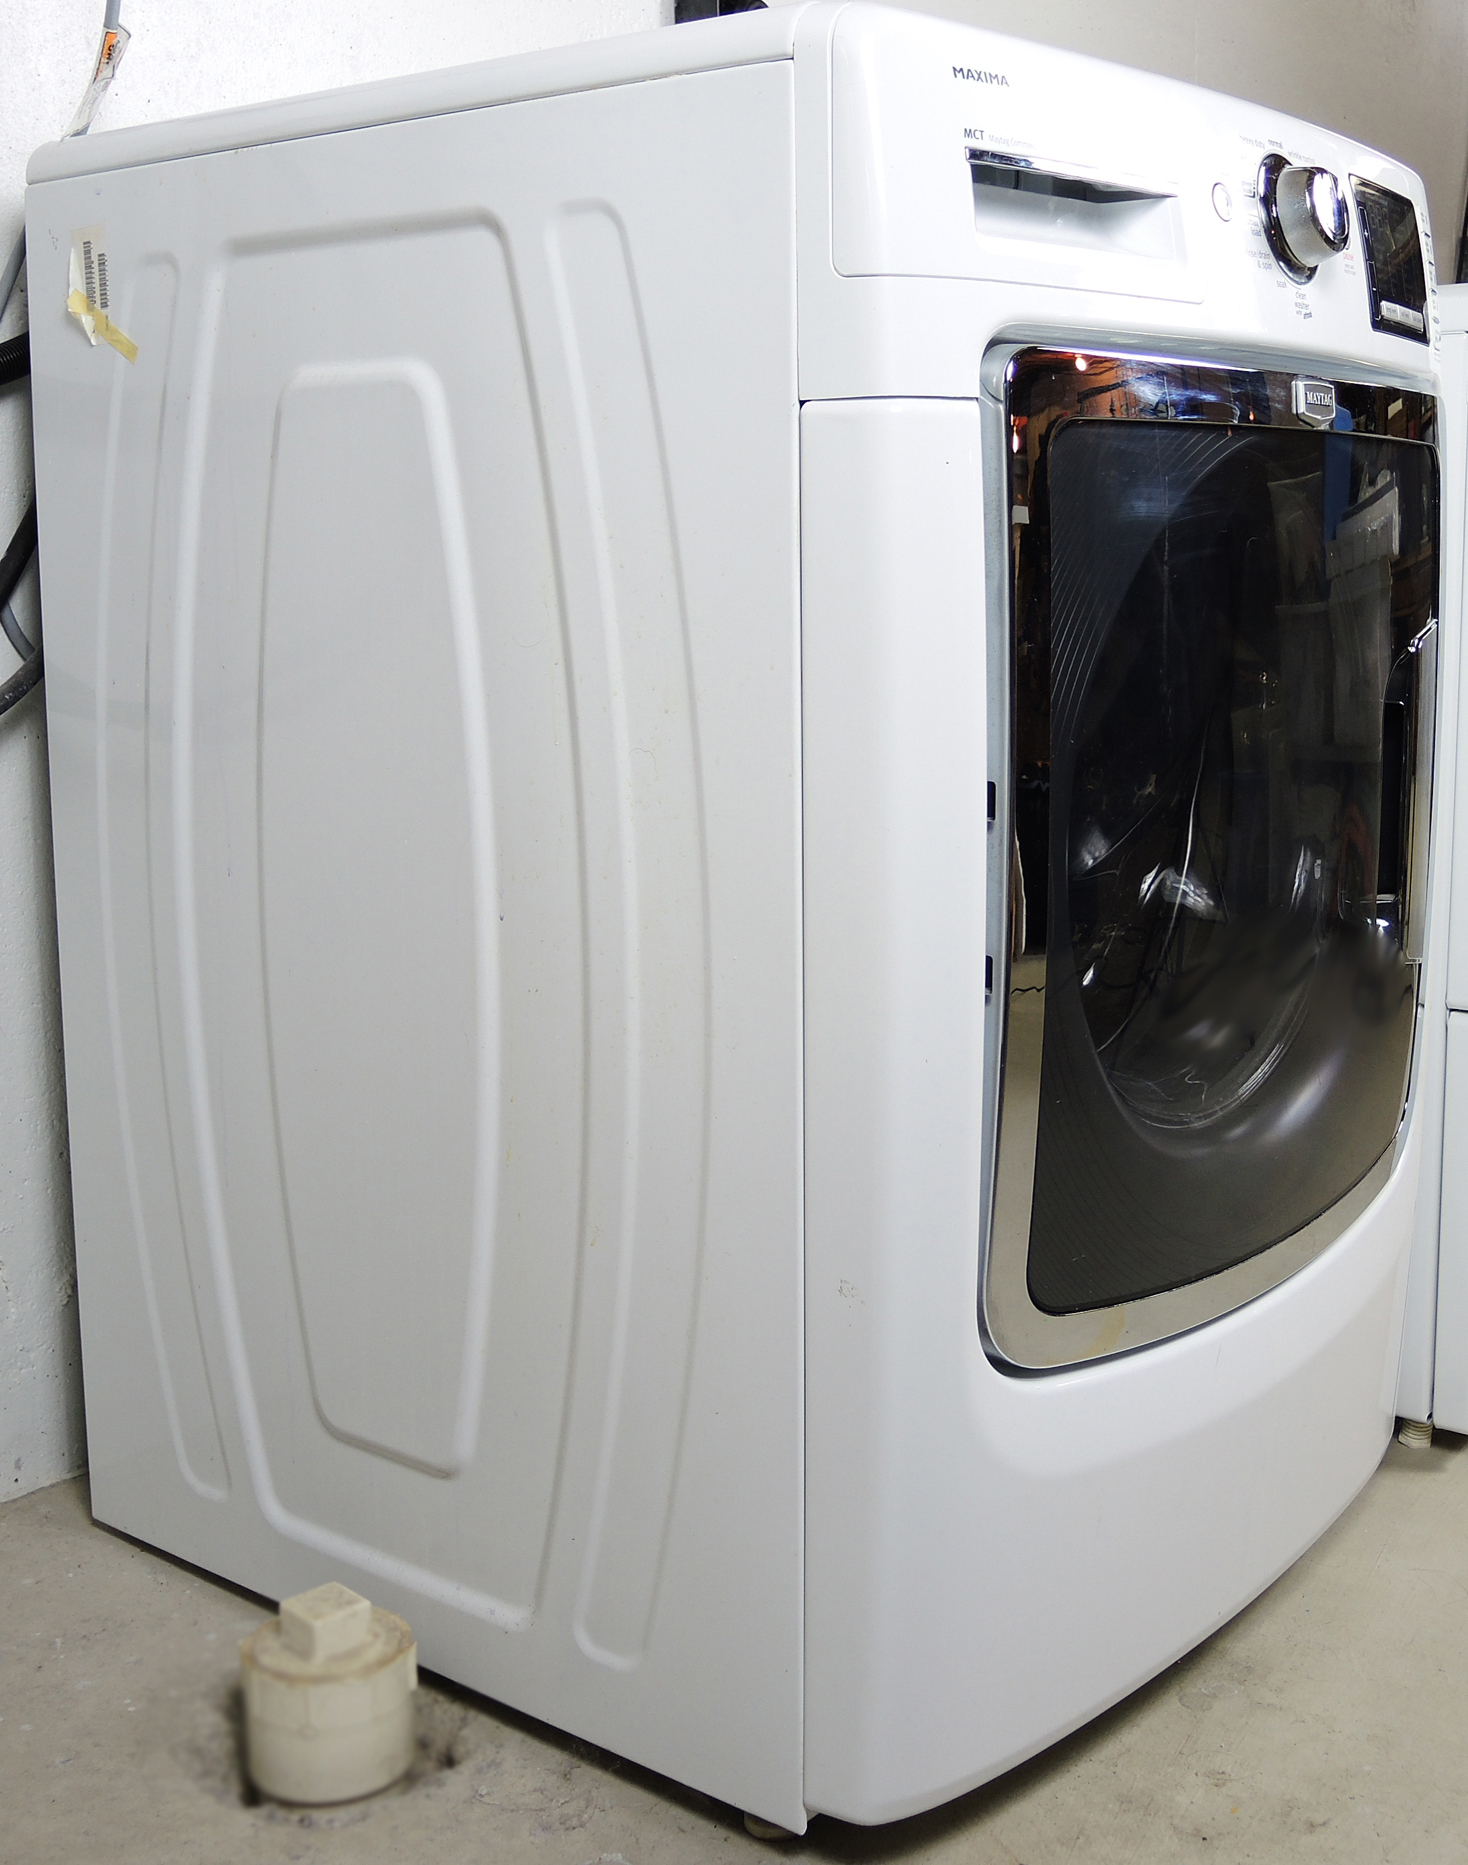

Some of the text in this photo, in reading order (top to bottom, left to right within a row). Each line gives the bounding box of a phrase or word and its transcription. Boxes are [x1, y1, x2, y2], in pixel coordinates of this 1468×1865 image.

[952, 66, 1010, 87] MAXIMA
[964, 128, 985, 141] MCT
[988, 134, 1010, 147] Maytag
[1306, 391, 1332, 406] MAYTAG
